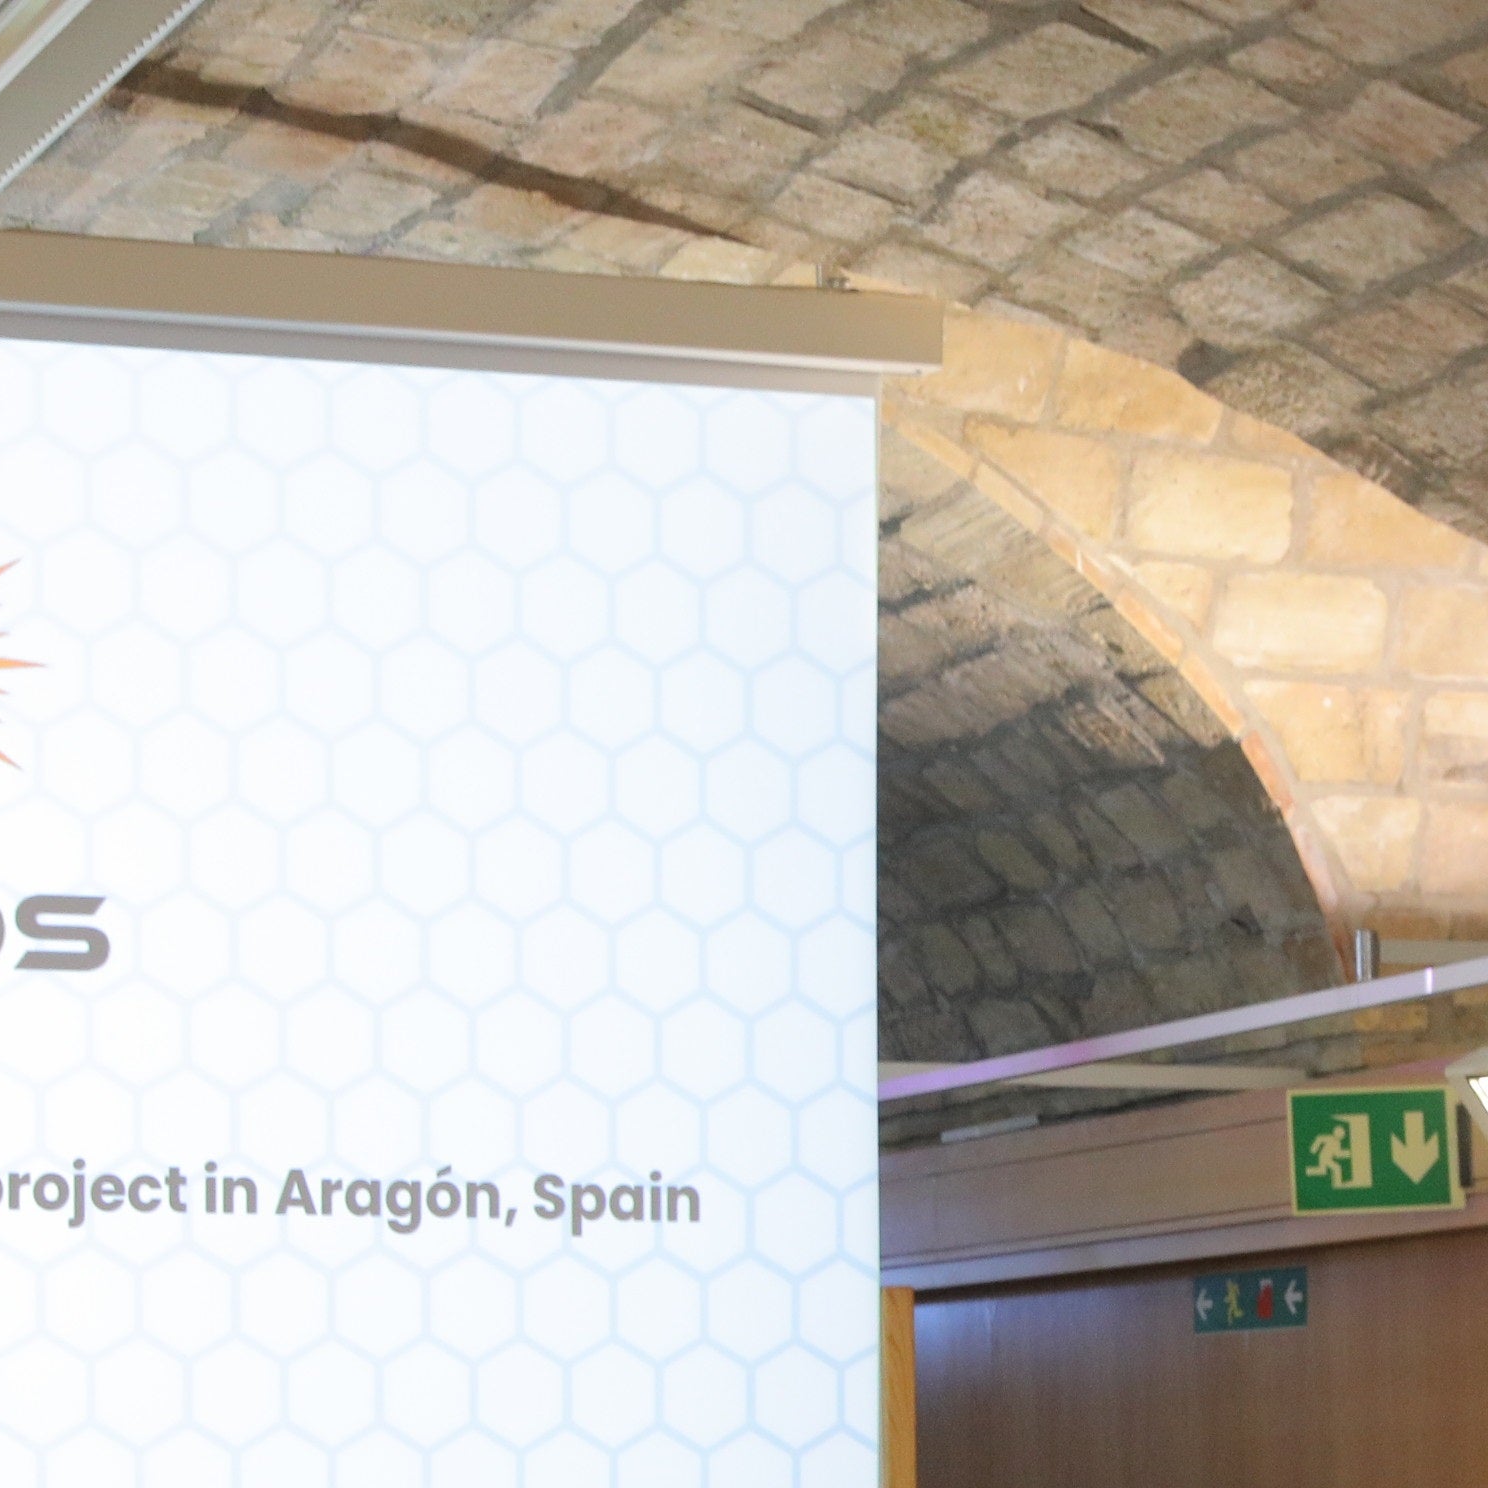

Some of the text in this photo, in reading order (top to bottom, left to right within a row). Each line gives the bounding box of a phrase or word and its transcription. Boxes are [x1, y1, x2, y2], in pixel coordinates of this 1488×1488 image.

[204, 1161, 258, 1214] in
[275, 1165, 518, 1235] Aragón,
[533, 1170, 700, 1237] Spain
